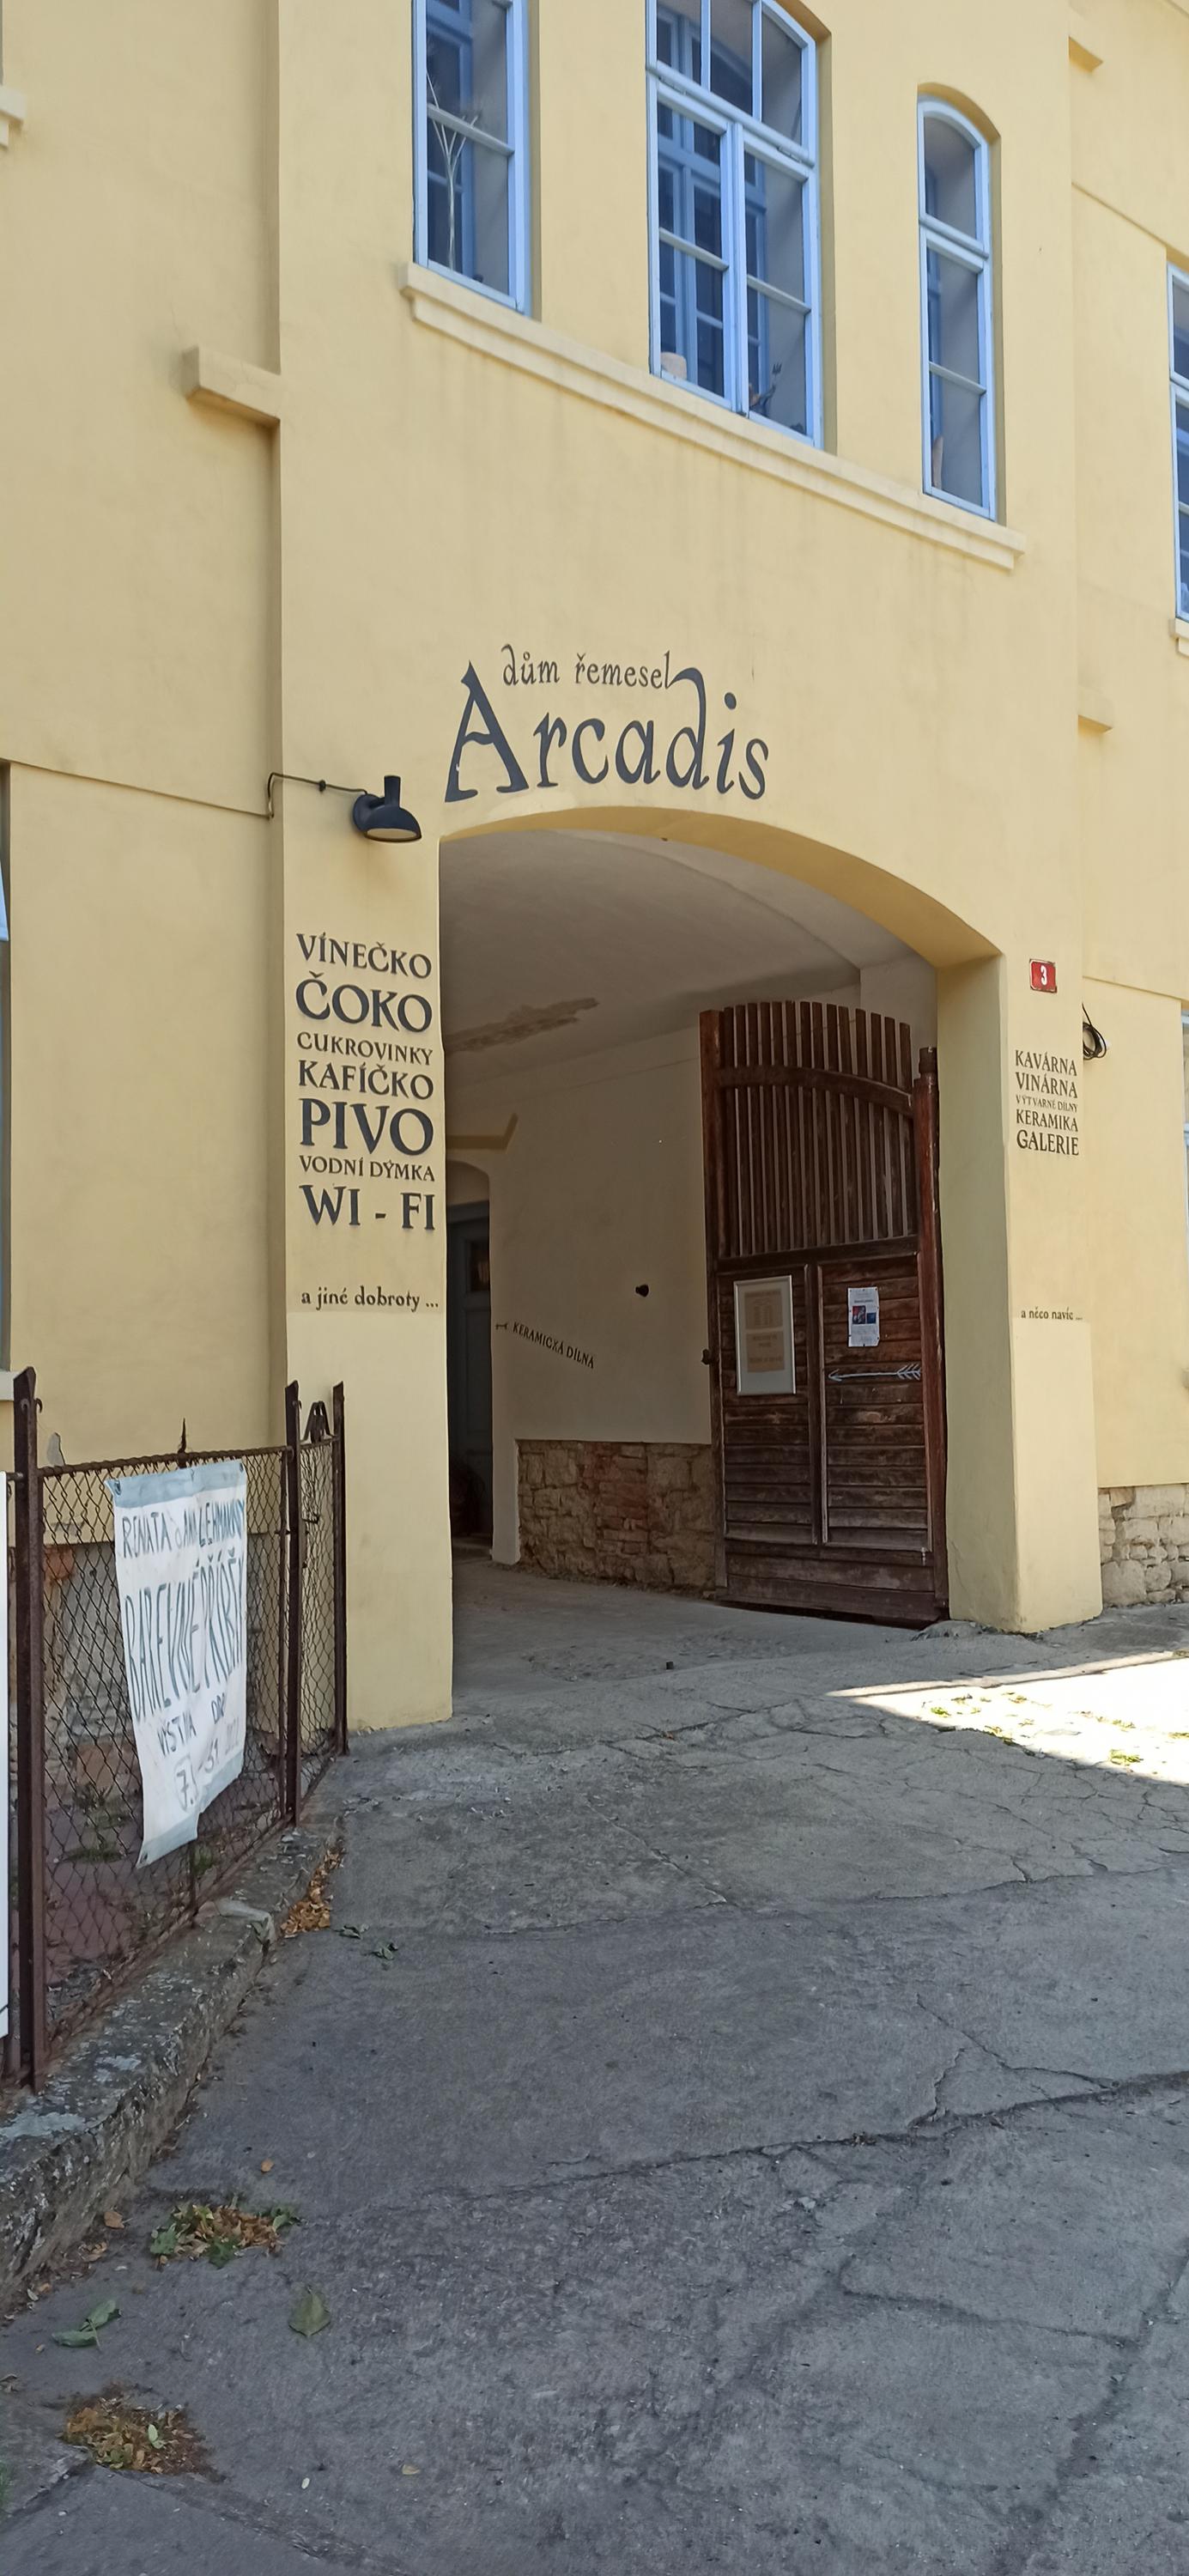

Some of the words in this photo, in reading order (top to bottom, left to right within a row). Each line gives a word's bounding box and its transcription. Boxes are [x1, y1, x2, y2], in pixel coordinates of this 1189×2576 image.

[500, 643, 561, 686] dům
[574, 650, 672, 690] řemesel
[444, 659, 769, 803] Arcadis
[296, 932, 433, 980] VÍNEČKO
[1040, 964, 1048, 987] 3
[295, 970, 434, 1034] ČOKO
[297, 1031, 434, 1066] CUKROVINKY
[1015, 1049, 1077, 1077] KAVÁRNA
[298, 1061, 434, 1101] KAFÍČKO
[1015, 1072, 1078, 1099] VINÁRNA
[299, 1097, 434, 1157] PIVO
[1016, 1109, 1079, 1133] KERAMIKA
[1016, 1129, 1080, 1157] GALERIE
[299, 1155, 364, 1177] VODNÍ
[369, 1159, 436, 1182] DÝMKA
[300, 1291, 312, 1304] a
[315, 1286, 349, 1311] jiné
[354, 1285, 421, 1313] dobroty
[1021, 1309, 1027, 1320] a
[1028, 1305, 1049, 1320] něco
[1052, 1306, 1074, 1321] navíc
[121, 1511, 173, 1559] RENATA
[124, 1558, 202, 1722] BAREVNÉ
